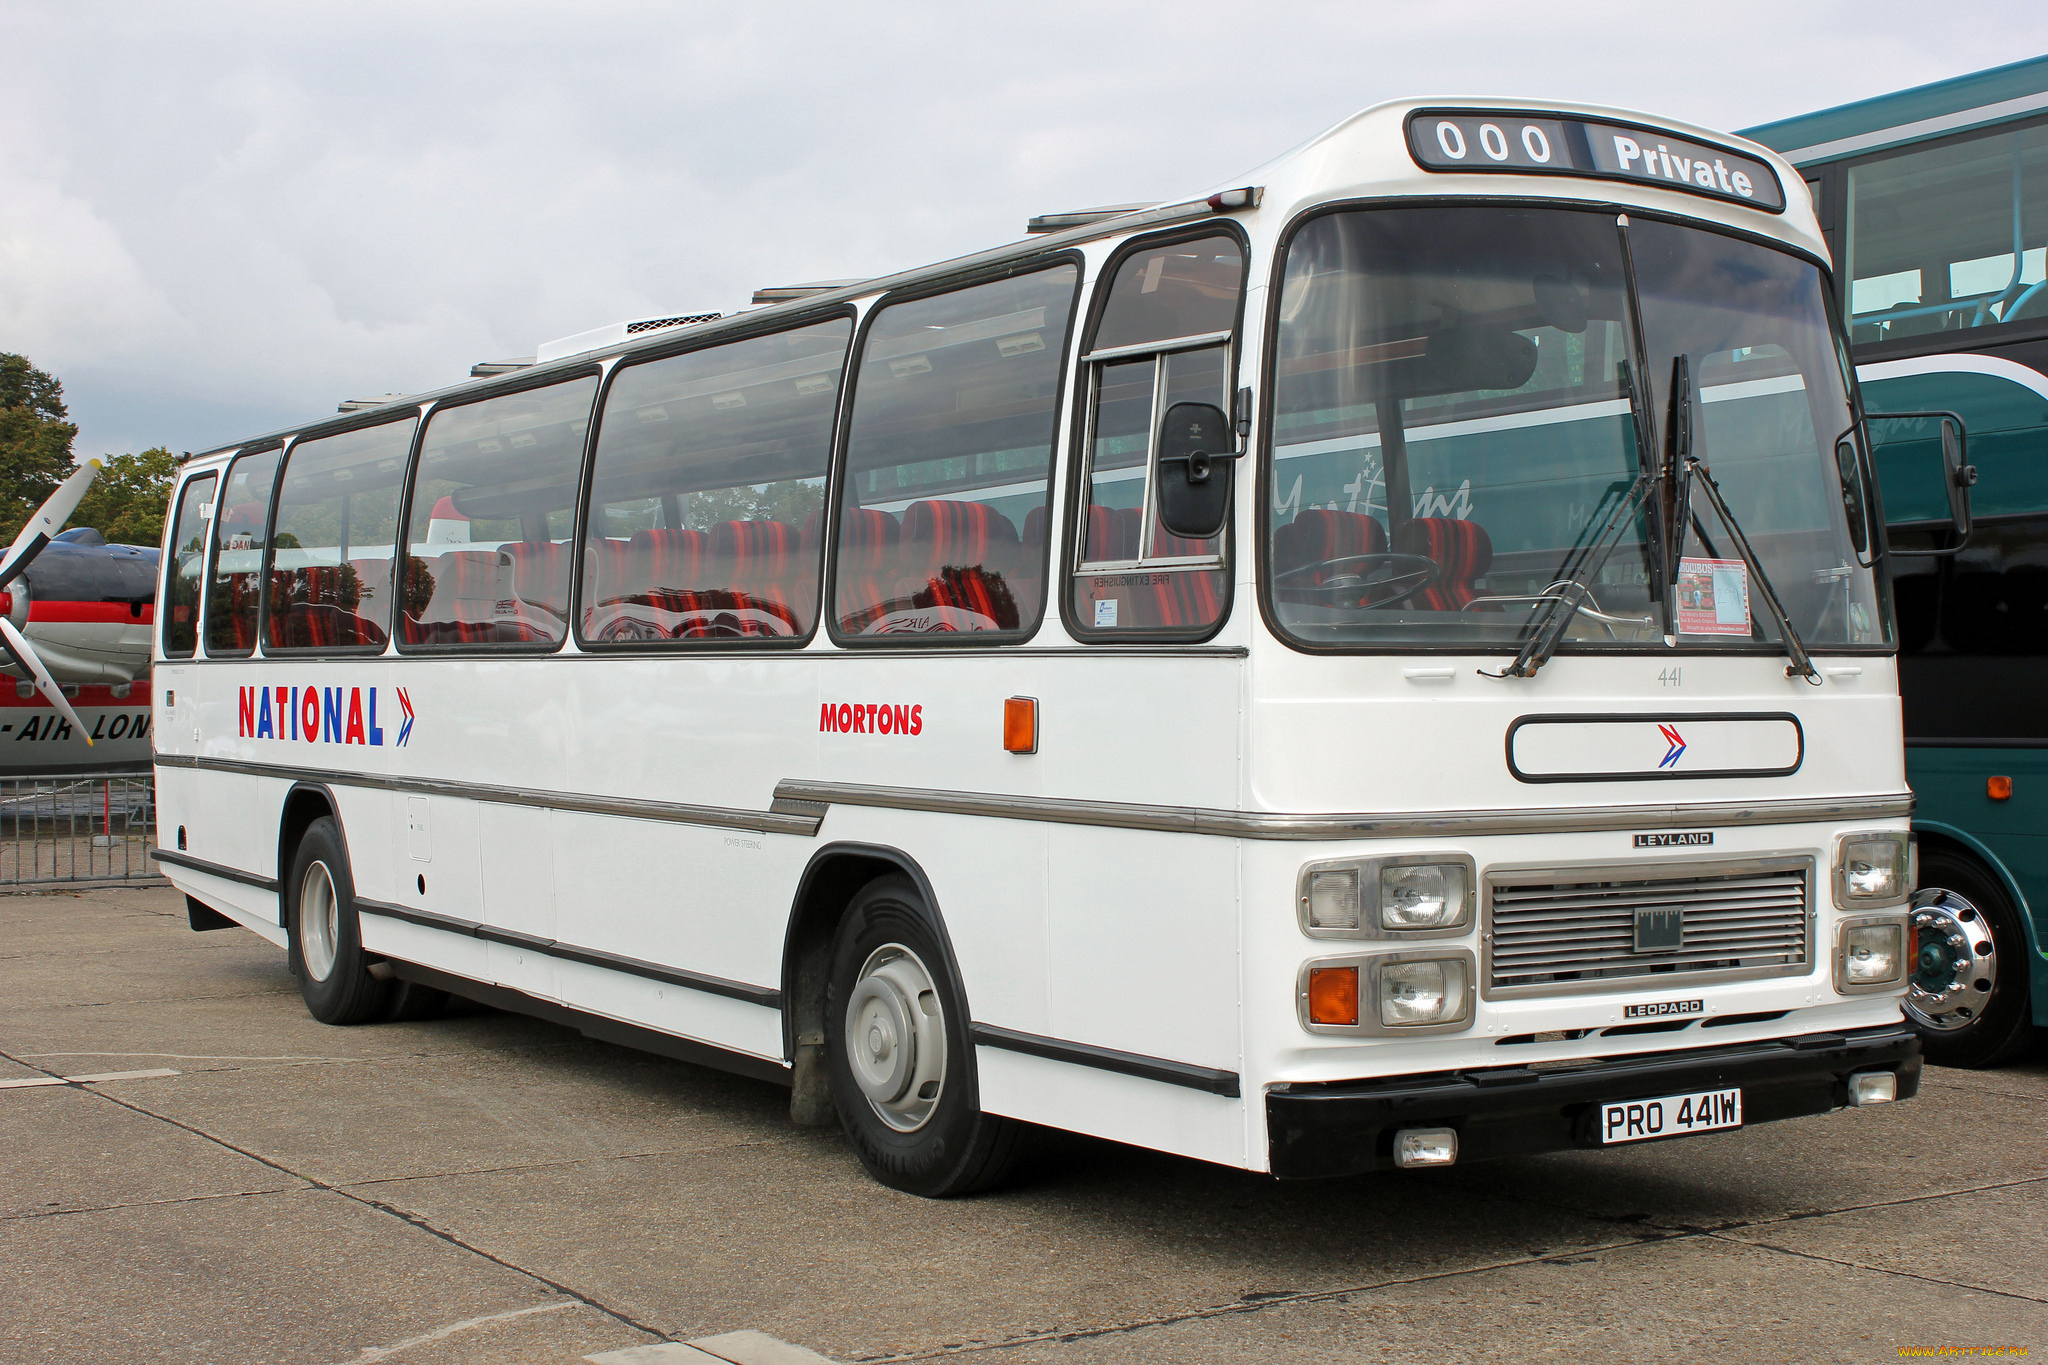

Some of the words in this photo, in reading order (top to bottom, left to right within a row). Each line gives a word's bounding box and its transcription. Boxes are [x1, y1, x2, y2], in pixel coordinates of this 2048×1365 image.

[1613, 135, 1753, 197] Private
[1680, 562, 1713, 574] HOWBUS
[1657, 666, 1681, 686] 441
[91, 714, 151, 740] LON
[240, 686, 383, 746] NATIONAL
[820, 703, 923, 736] MORTONS
[1638, 833, 1710, 846] LEYLAND
[1628, 1001, 1700, 1017] LEOPARD
[1607, 1102, 1663, 1139] PRO
[1676, 1092, 1736, 1128] 441W
